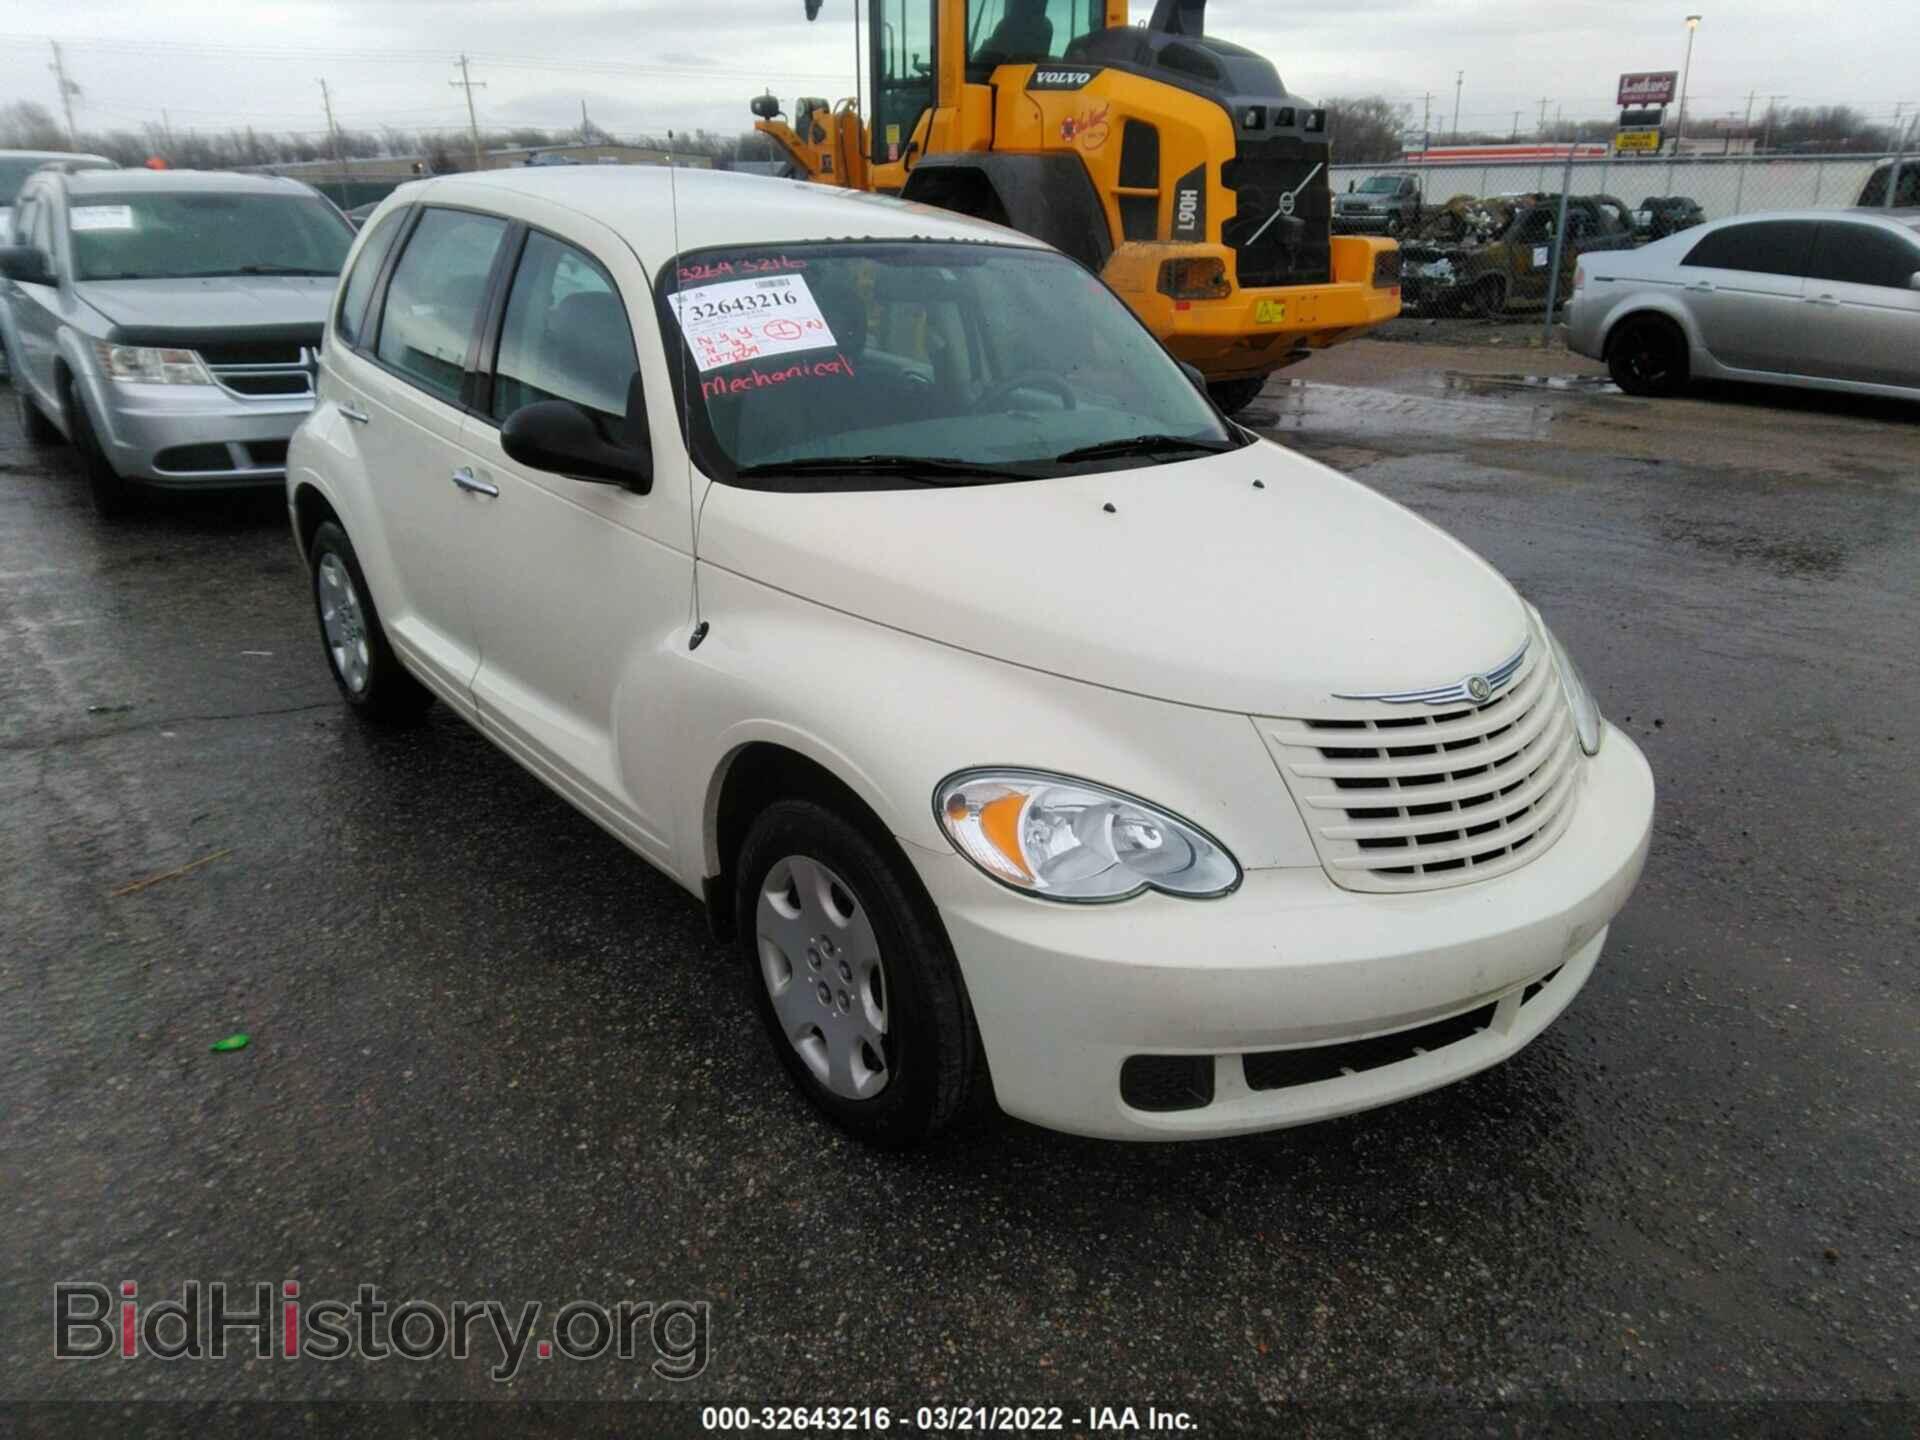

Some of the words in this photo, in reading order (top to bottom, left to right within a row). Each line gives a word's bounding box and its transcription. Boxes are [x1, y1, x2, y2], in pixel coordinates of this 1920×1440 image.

[1037, 71, 1091, 84] VOLVO
[1177, 189, 1199, 231] L90H
[689, 290, 797, 321] 32643216
[701, 352, 854, 399] Mechanical
